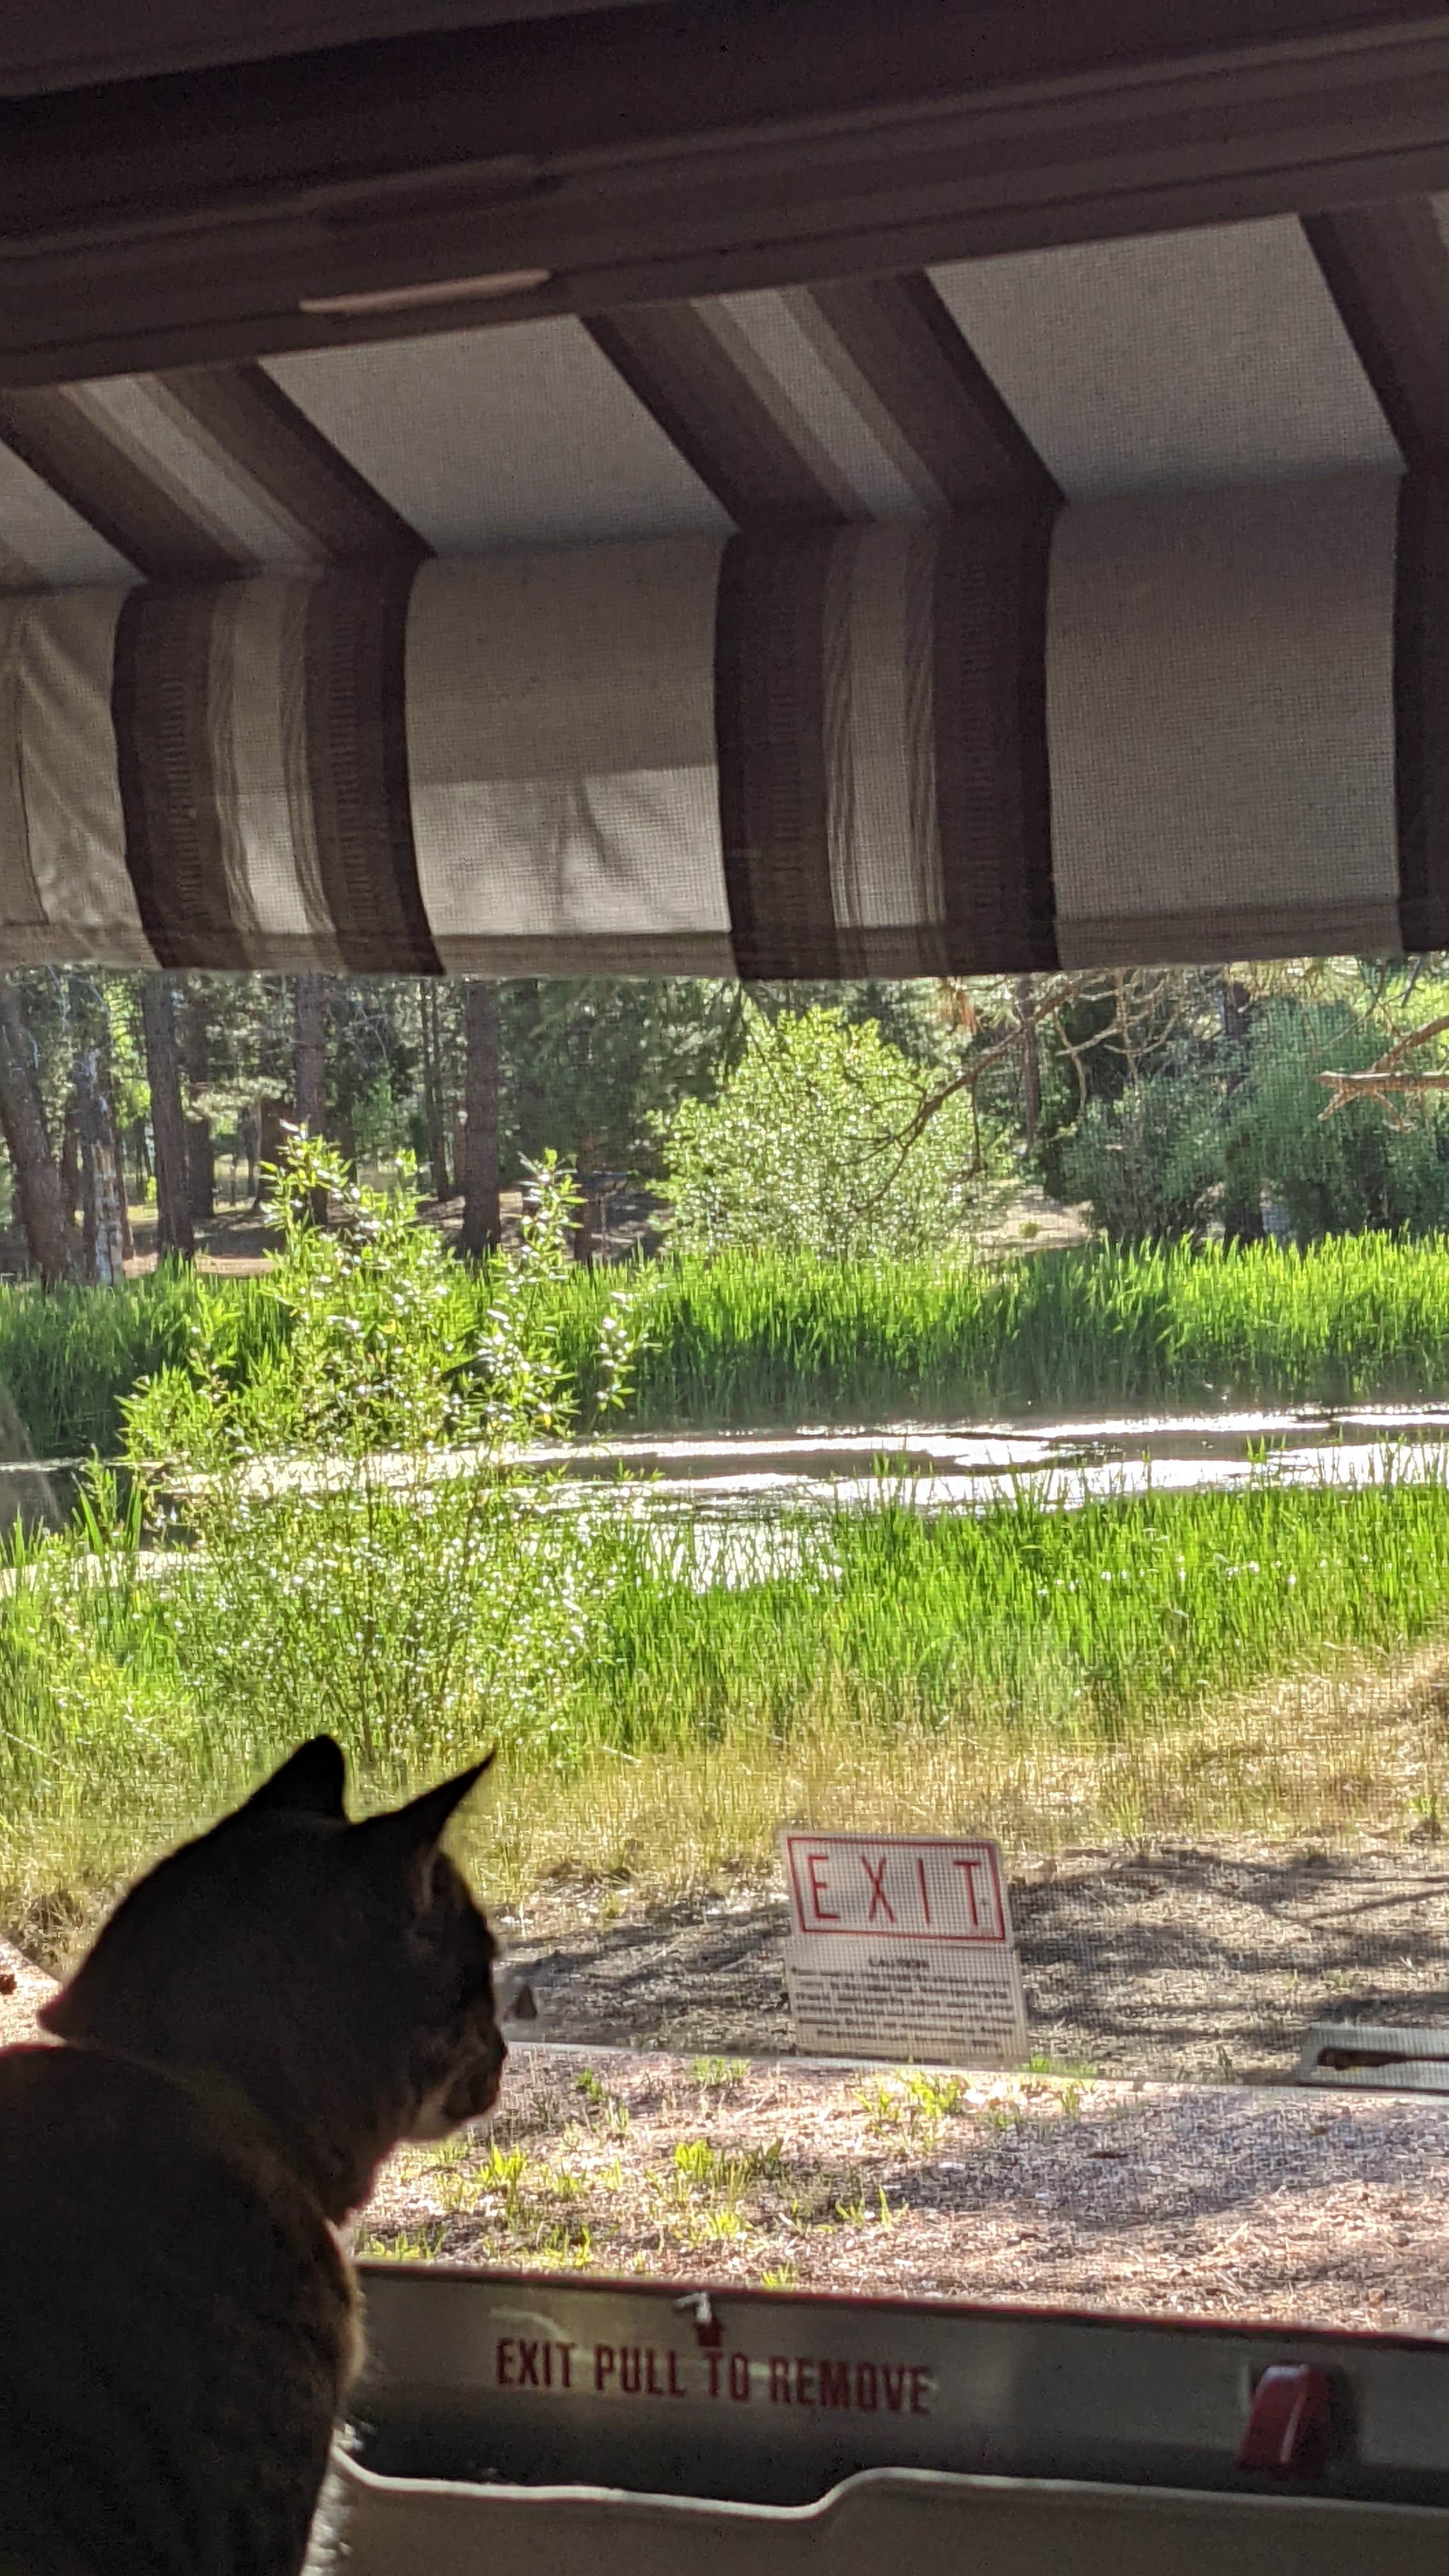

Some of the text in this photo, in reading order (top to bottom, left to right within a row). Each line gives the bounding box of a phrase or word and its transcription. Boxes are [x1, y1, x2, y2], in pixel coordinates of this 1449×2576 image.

[808, 1855, 981, 1926] EXIT
[495, 2337, 934, 2416] EXIT PULL TO REMOVE
